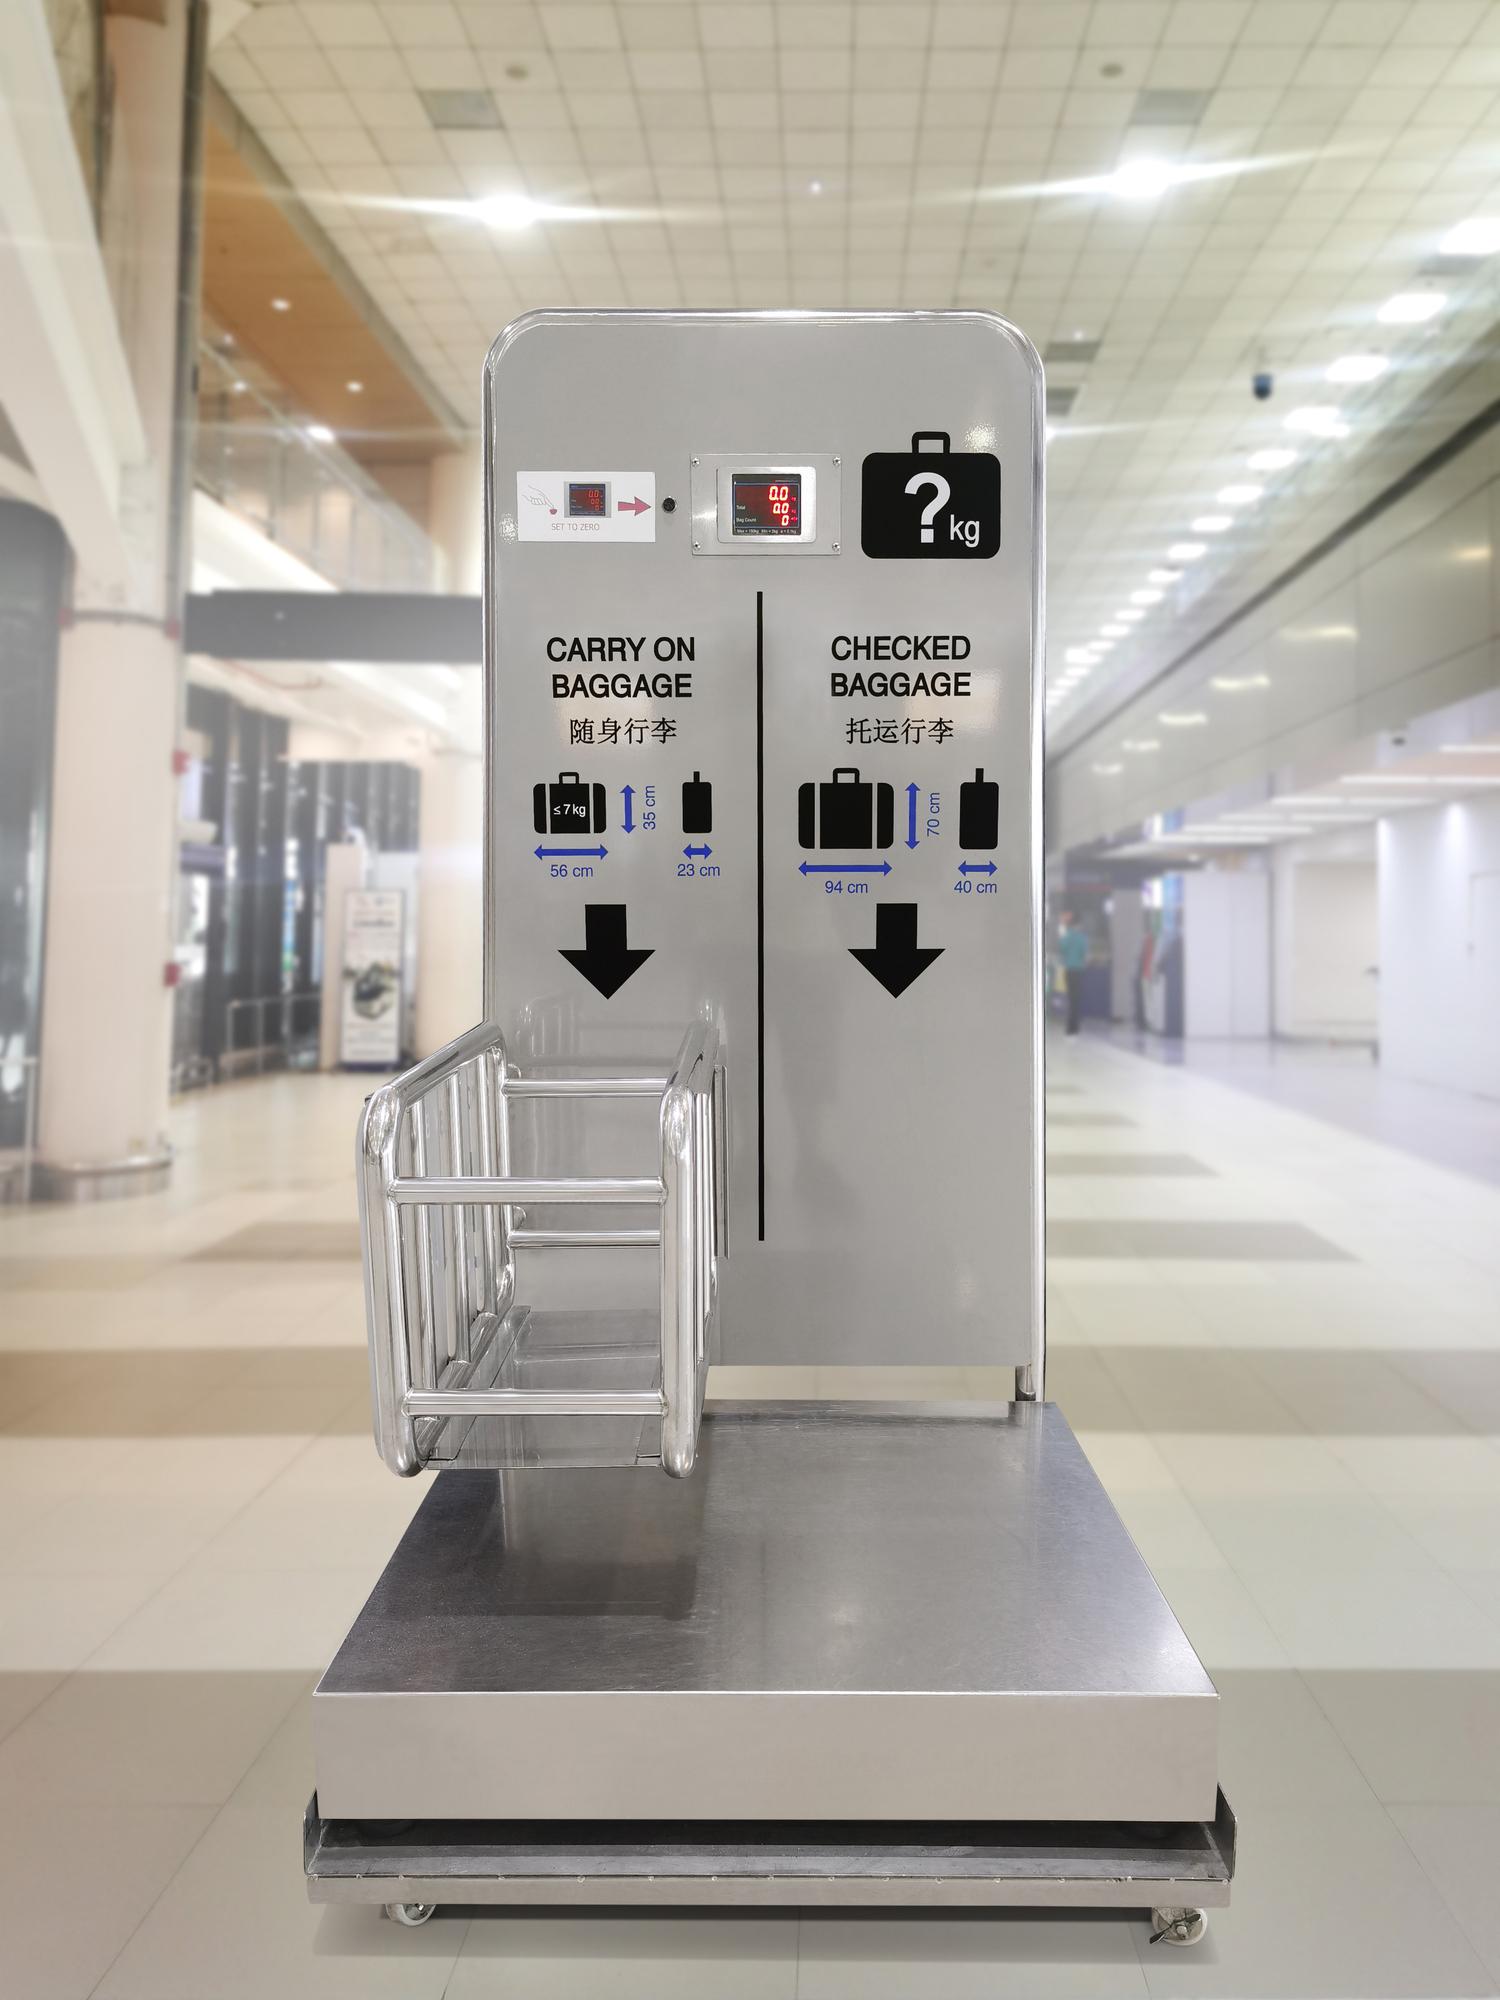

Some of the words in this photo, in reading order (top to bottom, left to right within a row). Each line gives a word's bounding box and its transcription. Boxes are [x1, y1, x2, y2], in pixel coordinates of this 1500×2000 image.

[551, 523, 566, 531] SET
[567, 523, 578, 531] TO
[580, 523, 600, 531] ZERO
[781, 514, 790, 526] 0
[950, 514, 981, 548] kg
[546, 636, 647, 662] CARRY
[653, 636, 695, 662] ON
[831, 635, 971, 661] CHECKED
[552, 673, 693, 698] BAGGAGE
[831, 672, 971, 697] BAGGAGE
[569, 716, 677, 745] 随身行李
[846, 716, 954, 745] 托运行李
[645, 785, 656, 807] cm
[930, 792, 940, 814] cm
[642, 811, 656, 830] 35
[927, 818, 940, 837] 70
[550, 864, 568, 878] 56
[572, 866, 593, 878] cm
[676, 863, 695, 878] 23
[699, 866, 721, 877] cm
[824, 880, 843, 894] 94
[847, 883, 868, 894] cm
[954, 880, 972, 894] 40
[976, 883, 998, 894] cm
